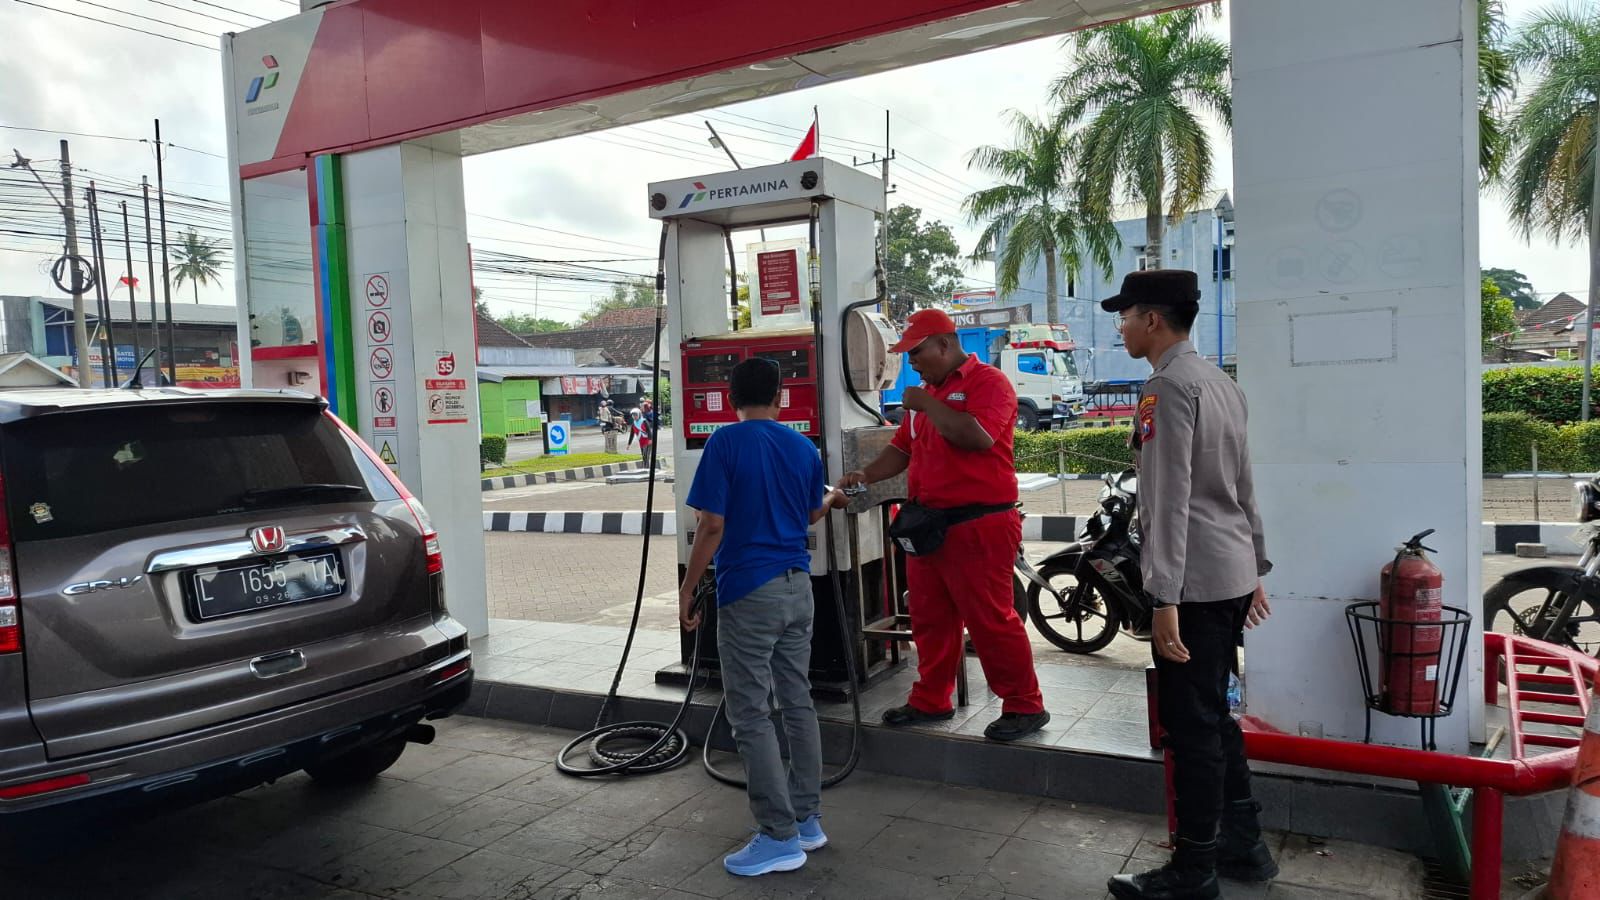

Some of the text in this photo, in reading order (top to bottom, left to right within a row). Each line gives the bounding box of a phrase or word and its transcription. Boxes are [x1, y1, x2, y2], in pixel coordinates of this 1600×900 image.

[709, 179, 788, 200] PERTAMINA
[199, 576, 215, 601] L
[239, 564, 287, 595] 1655
